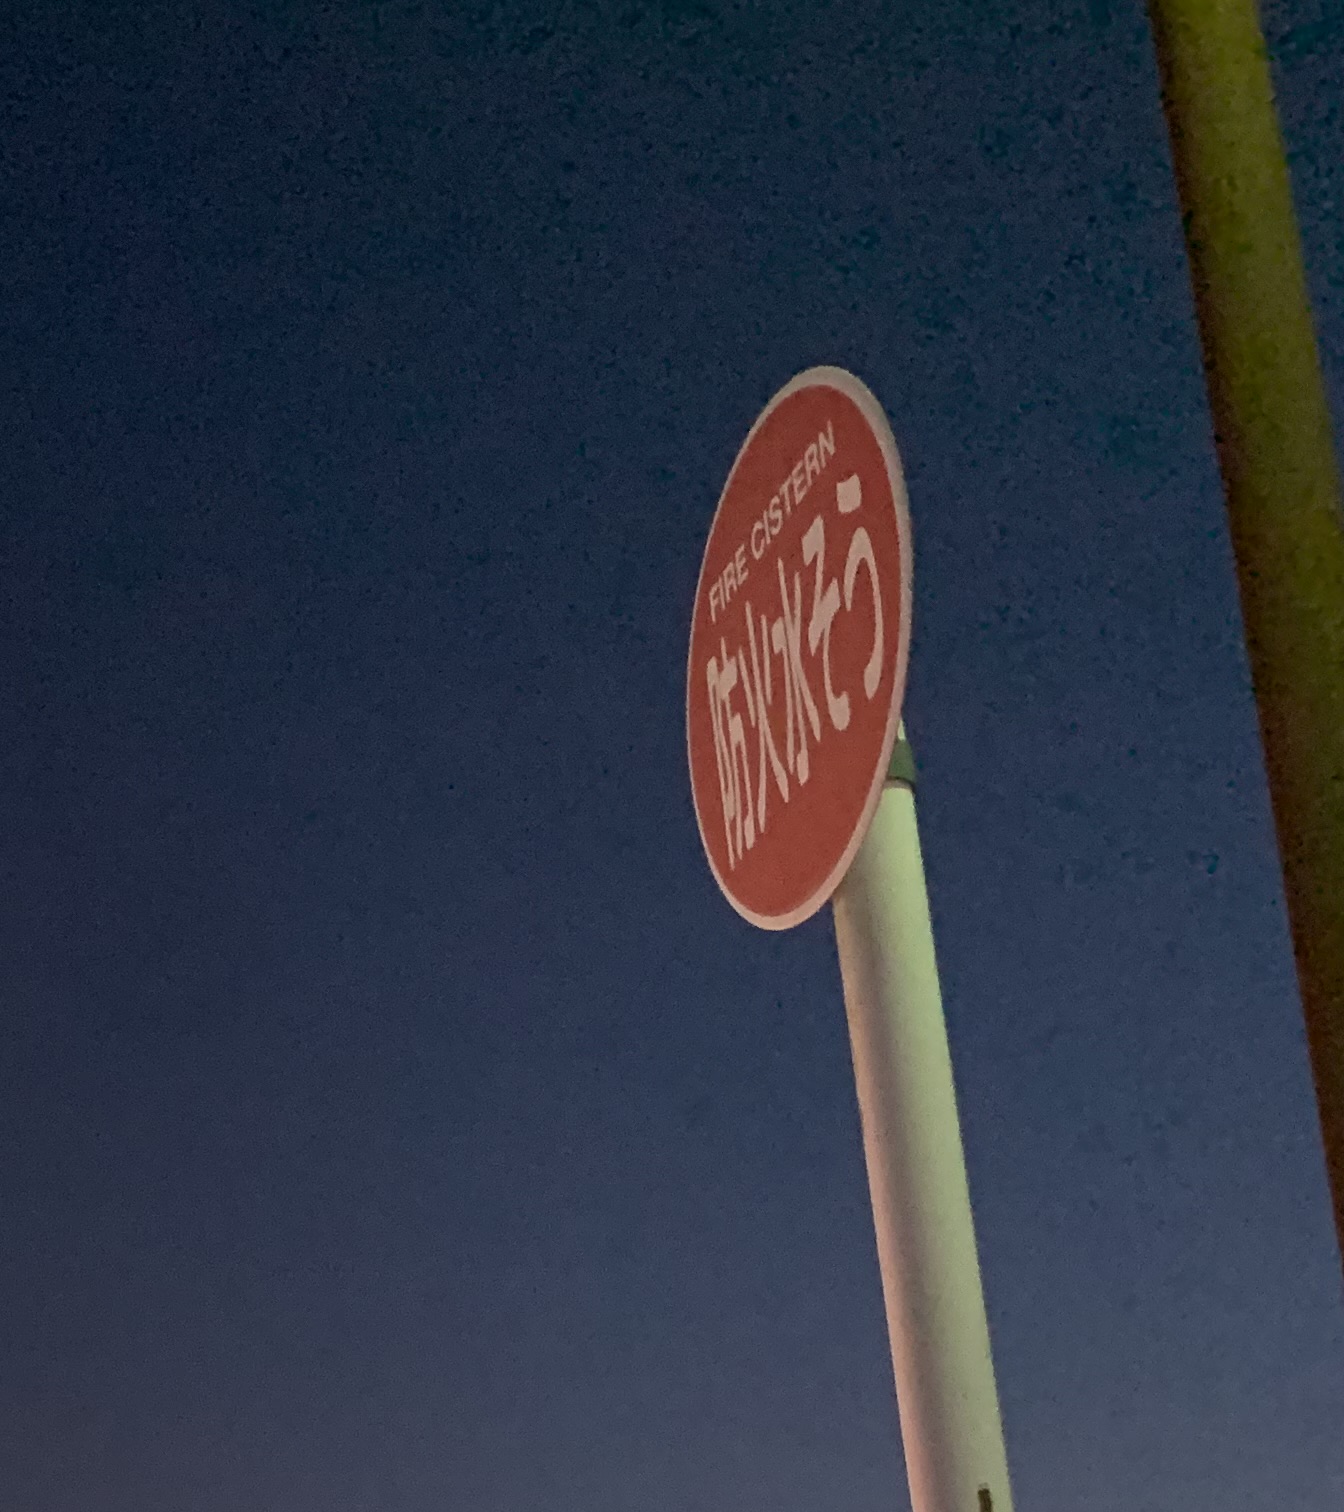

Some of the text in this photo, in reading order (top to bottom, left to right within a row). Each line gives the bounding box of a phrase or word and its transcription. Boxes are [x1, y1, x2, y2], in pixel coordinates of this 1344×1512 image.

[706, 472, 885, 872] 防火水そう
[709, 419, 836, 624] FIRE CISTERN
